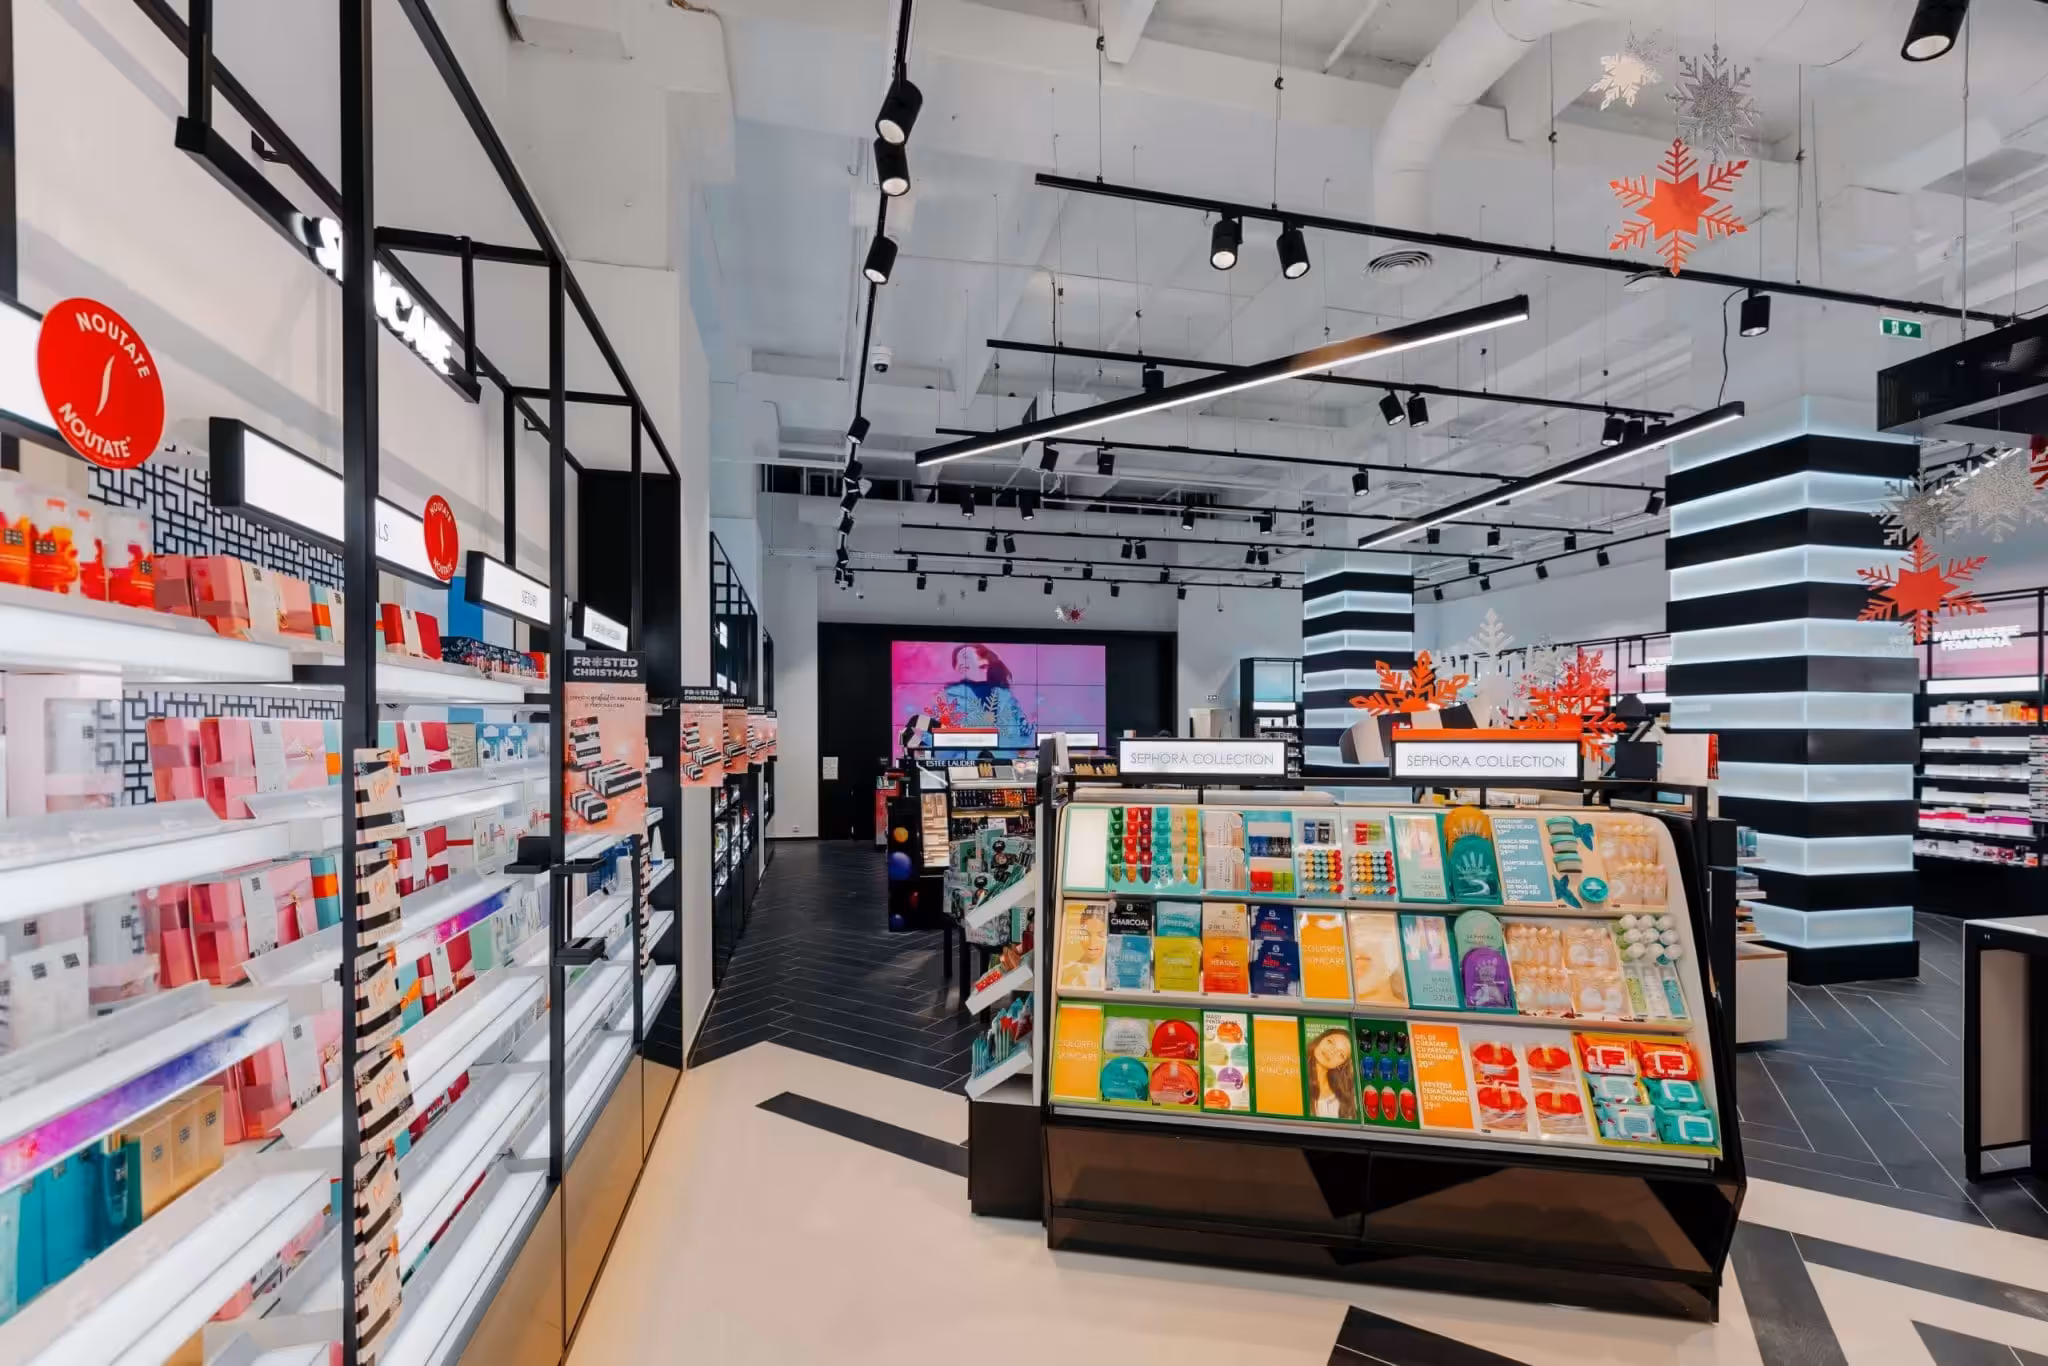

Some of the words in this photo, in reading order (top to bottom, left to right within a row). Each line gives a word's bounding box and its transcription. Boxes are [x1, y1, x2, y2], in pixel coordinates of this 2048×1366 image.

[75, 312, 150, 378] NOUTATE
[573, 667, 638, 678] CHRISTMAS
[1130, 752, 1188, 766] SEPHORA
[1192, 752, 1274, 767] COLLECTION
[1406, 755, 1471, 769] SEPHORA
[1475, 755, 1565, 769] COLLECTION
[1111, 917, 1150, 927] CHARCOAL
